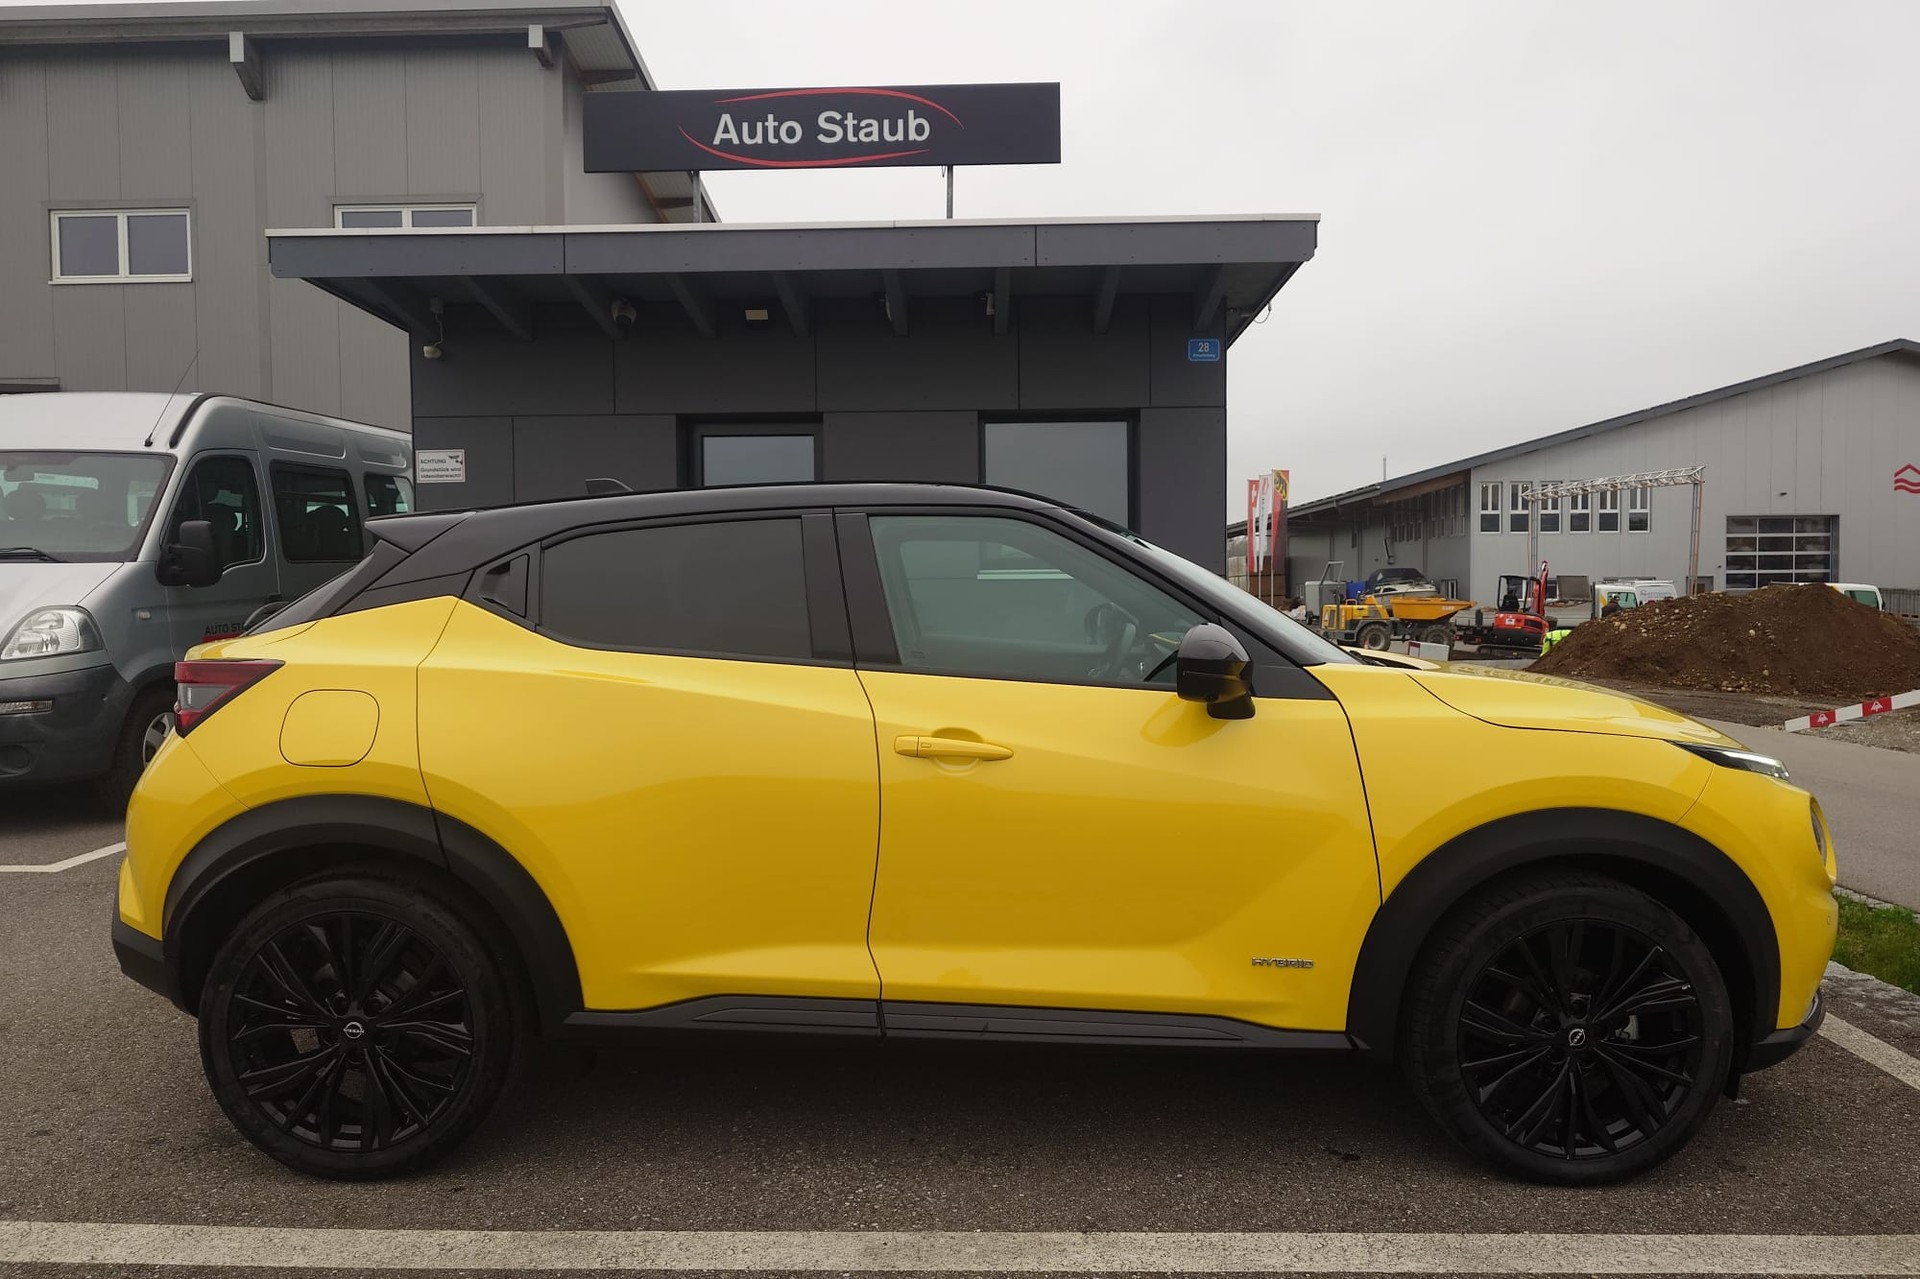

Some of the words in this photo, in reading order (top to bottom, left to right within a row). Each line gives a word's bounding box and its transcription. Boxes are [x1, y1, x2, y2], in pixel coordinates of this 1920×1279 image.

[713, 113, 803, 145] Auto
[816, 110, 931, 144] Staub
[1198, 342, 1210, 353] 28
[205, 623, 229, 636] AUTO
[1251, 956, 1314, 968] HYBRID
